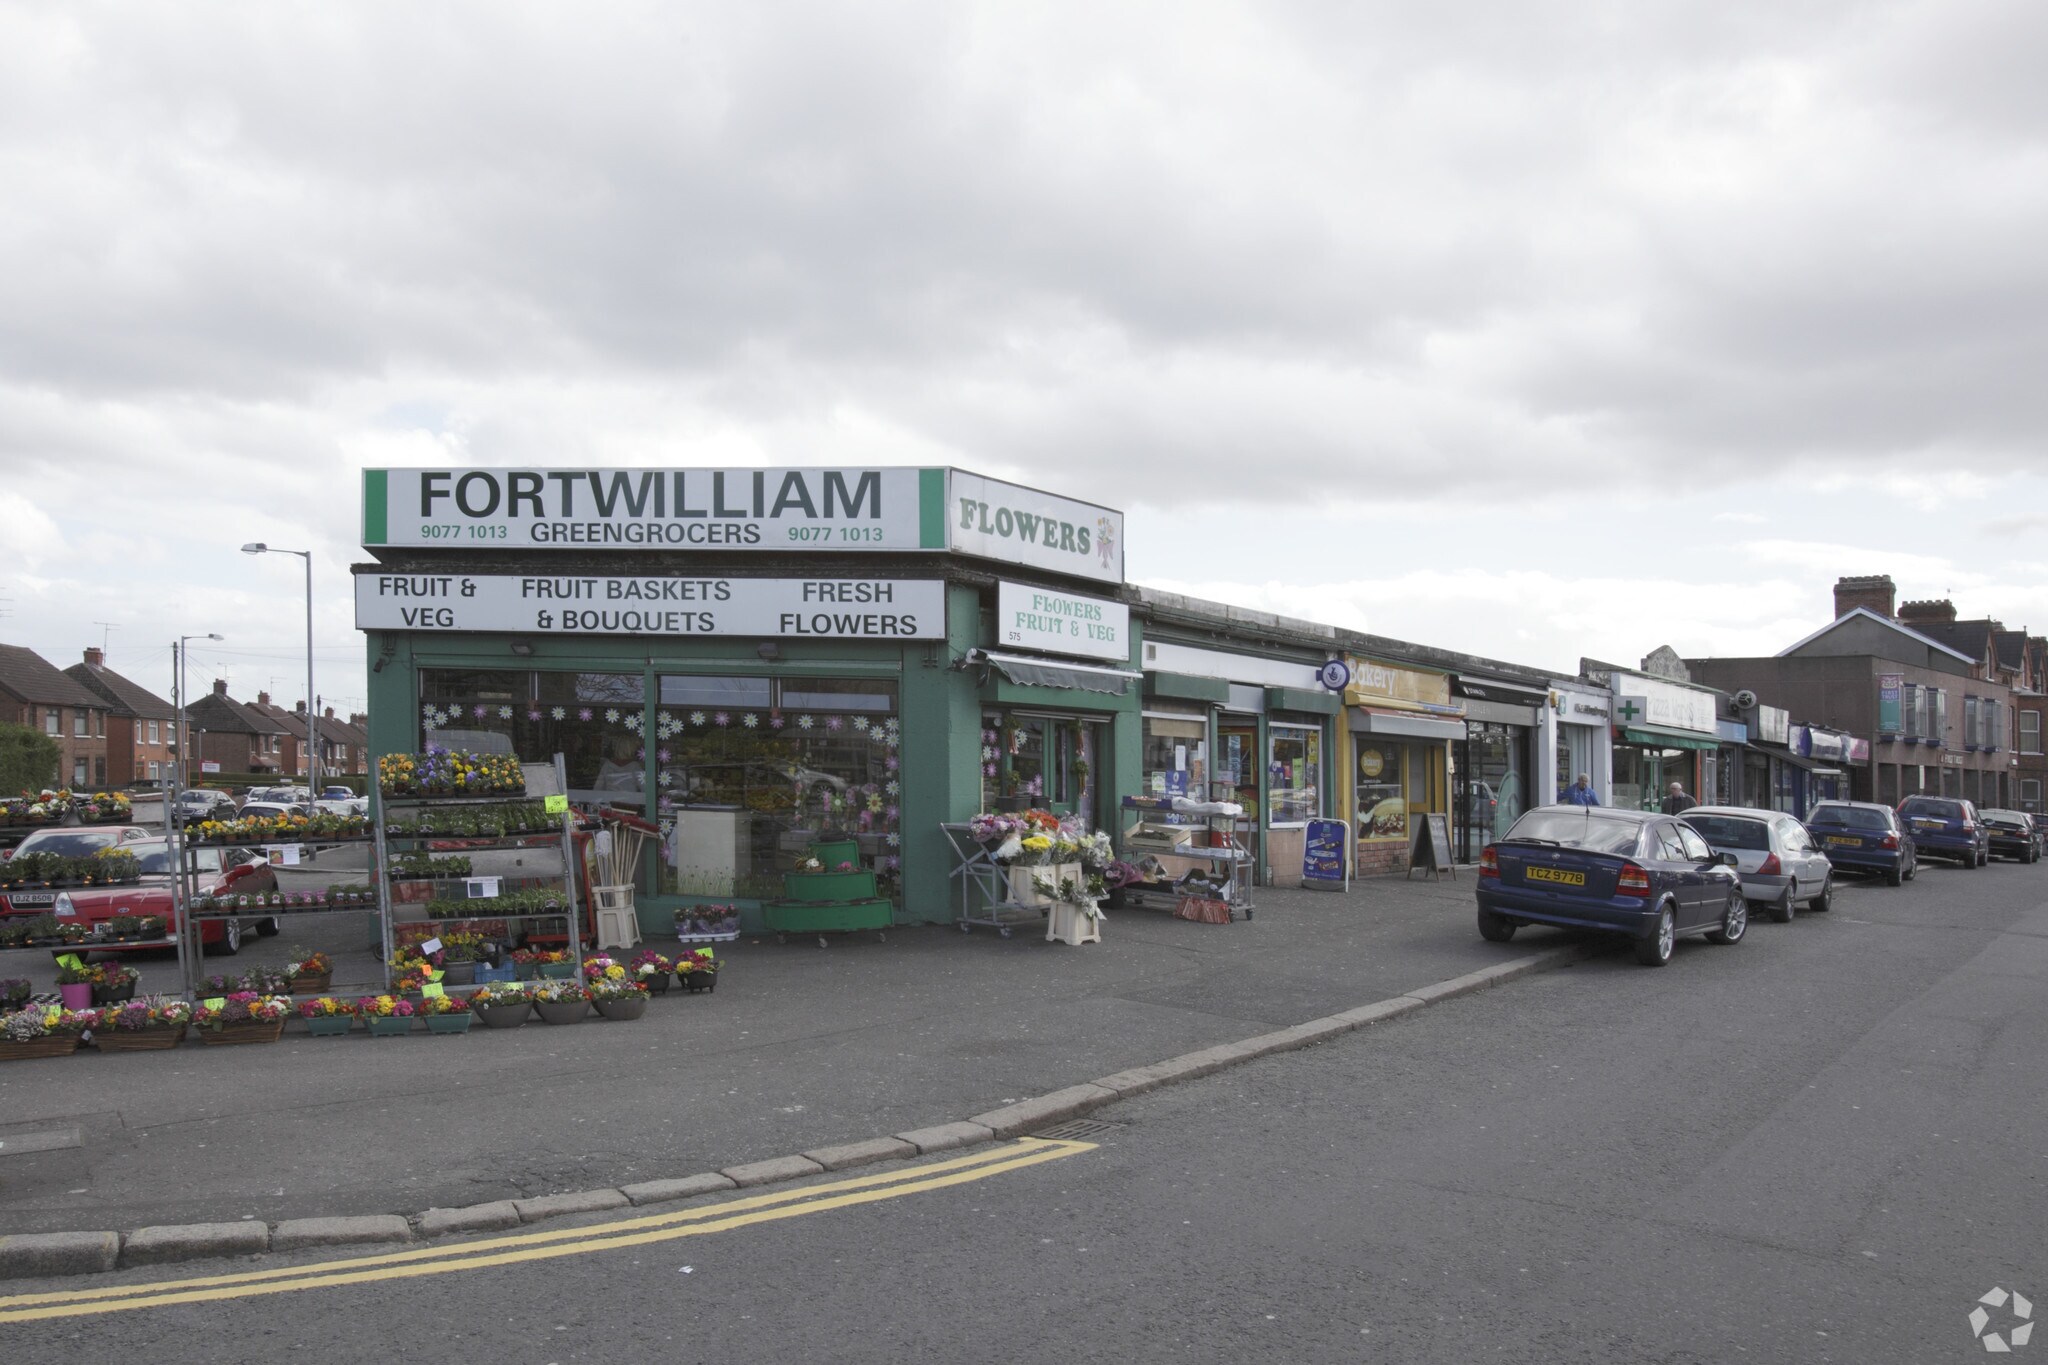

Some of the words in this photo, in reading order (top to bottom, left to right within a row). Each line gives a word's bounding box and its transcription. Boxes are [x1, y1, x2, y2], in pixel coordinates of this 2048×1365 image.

[420, 470, 882, 519] FORTWILLIAM
[421, 525, 461, 539] 9077
[468, 525, 507, 539] 1013
[530, 521, 761, 544] GREENGROCERS
[788, 527, 832, 541] 9077
[840, 527, 883, 541] 1013
[959, 497, 1091, 555] FLOWERS
[378, 576, 452, 597] FRUIT
[459, 578, 478, 598] &
[521, 578, 598, 600] FRUIT
[606, 580, 731, 601] BASKETS
[801, 581, 894, 603] FRESH
[399, 606, 455, 628] VEG
[1032, 594, 1102, 621] FLOWERS
[536, 609, 555, 630] &
[561, 610, 715, 633] BOUQUETS
[779, 613, 918, 636] FLOWERS
[1015, 612, 1063, 634] FRUIT
[1070, 620, 1079, 636] &
[1087, 623, 1115, 642] VEG
[1009, 632, 1021, 641] 575
[1348, 658, 1396, 696] Bakery
[1529, 868, 1552, 879] TCZ
[1553, 871, 1583, 883] 9778
[32, 894, 51, 902] 8508
